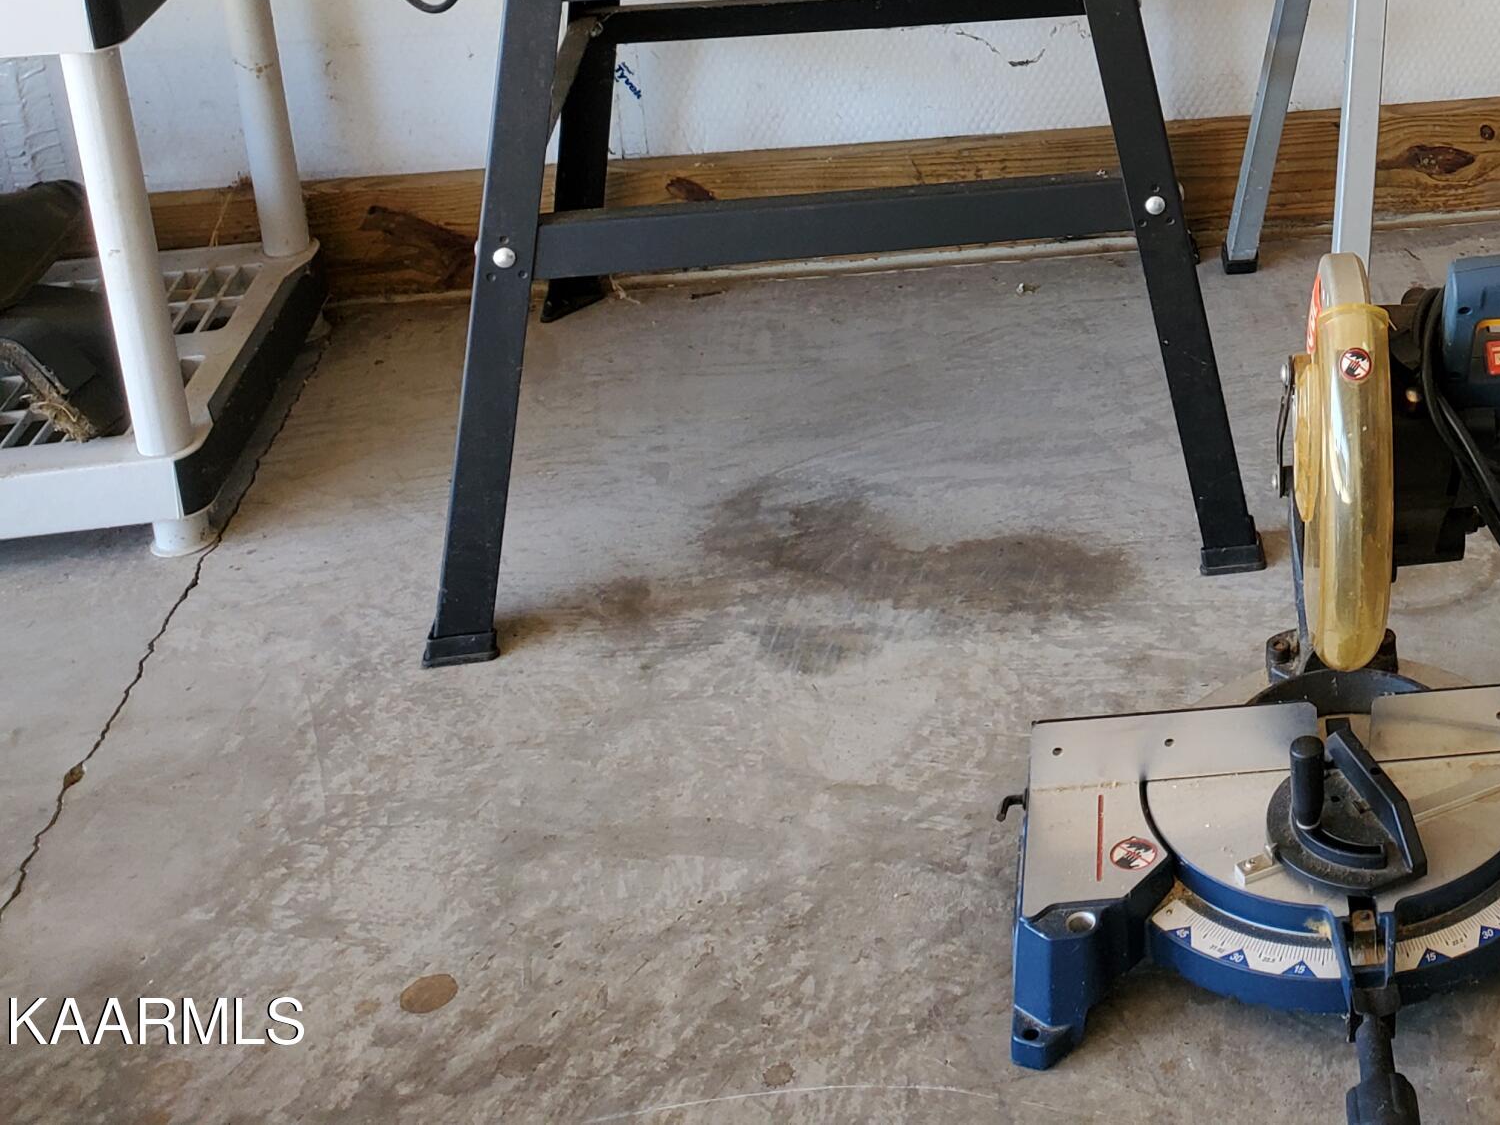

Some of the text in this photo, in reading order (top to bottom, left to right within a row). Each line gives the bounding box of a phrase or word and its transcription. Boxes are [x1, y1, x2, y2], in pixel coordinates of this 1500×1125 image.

[1482, 929, 1494, 939] 30
[1229, 953, 1244, 963] 30
[1425, 951, 1437, 962] 15
[1294, 965, 1306, 975] 15
